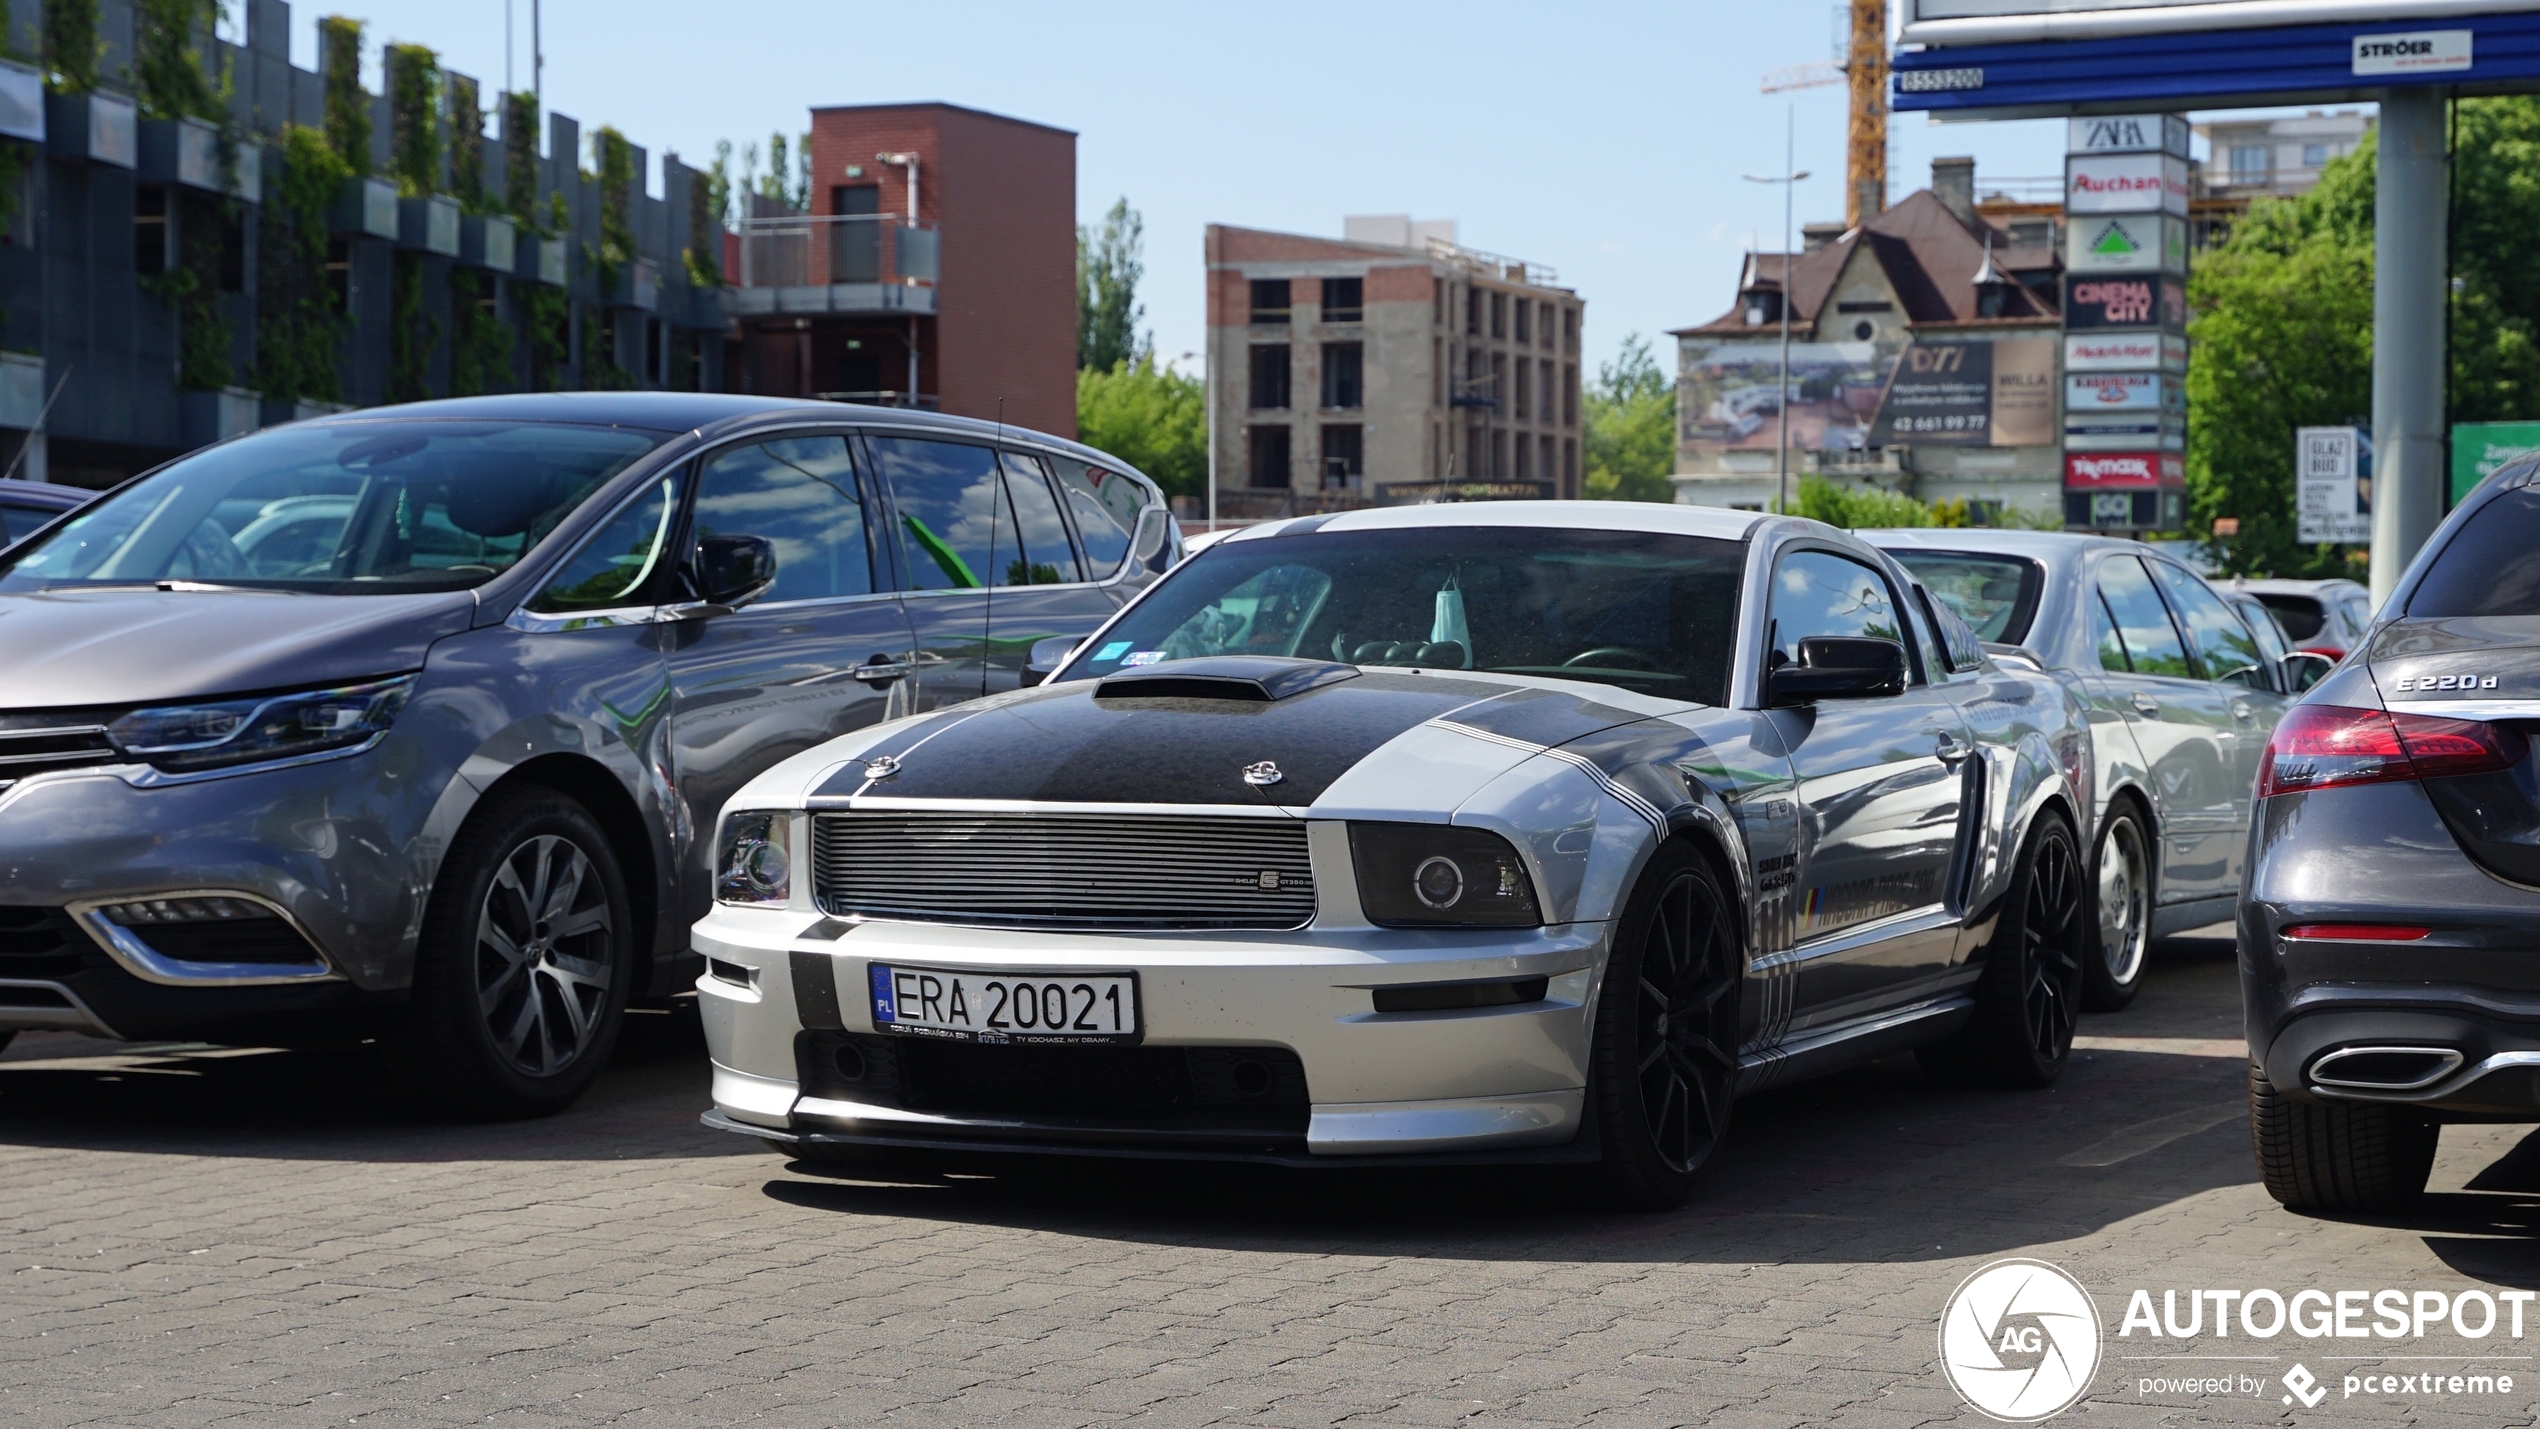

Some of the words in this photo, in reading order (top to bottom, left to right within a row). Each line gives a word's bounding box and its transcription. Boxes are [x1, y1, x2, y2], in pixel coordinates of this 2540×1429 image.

[2086, 120, 2145, 147] ZARA
[2073, 174, 2161, 193] Auchan
[2074, 282, 2152, 304] CINEMA
[2105, 301, 2149, 321] CITY
[1998, 374, 2048, 385] WILLA
[877, 999, 892, 1014] PL
[894, 972, 971, 1026] ERA
[985, 981, 1122, 1032] 20021
